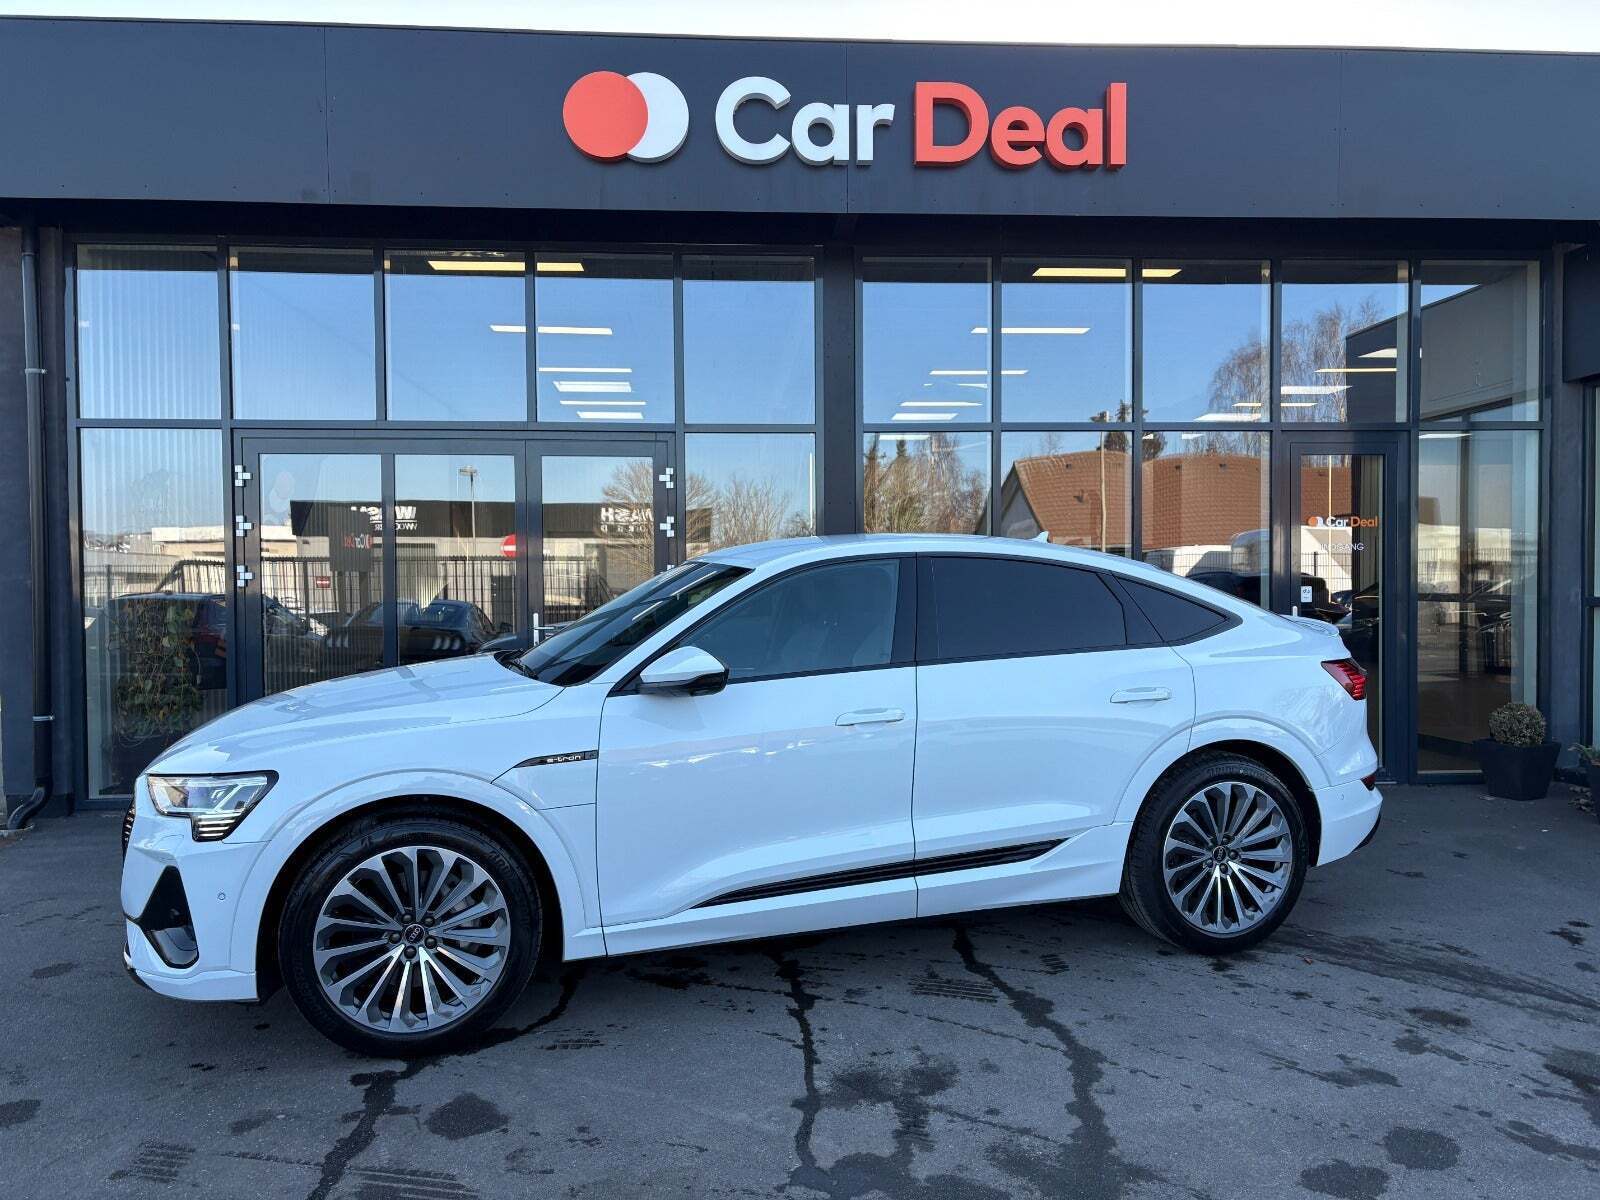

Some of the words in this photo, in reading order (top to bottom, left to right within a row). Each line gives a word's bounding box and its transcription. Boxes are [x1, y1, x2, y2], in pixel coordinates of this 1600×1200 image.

[715, 76, 896, 166] Car
[914, 81, 1127, 168] Deal
[1326, 515, 1348, 527] Car
[1350, 516, 1378, 527] Deal
[546, 755, 581, 763] e-tron
